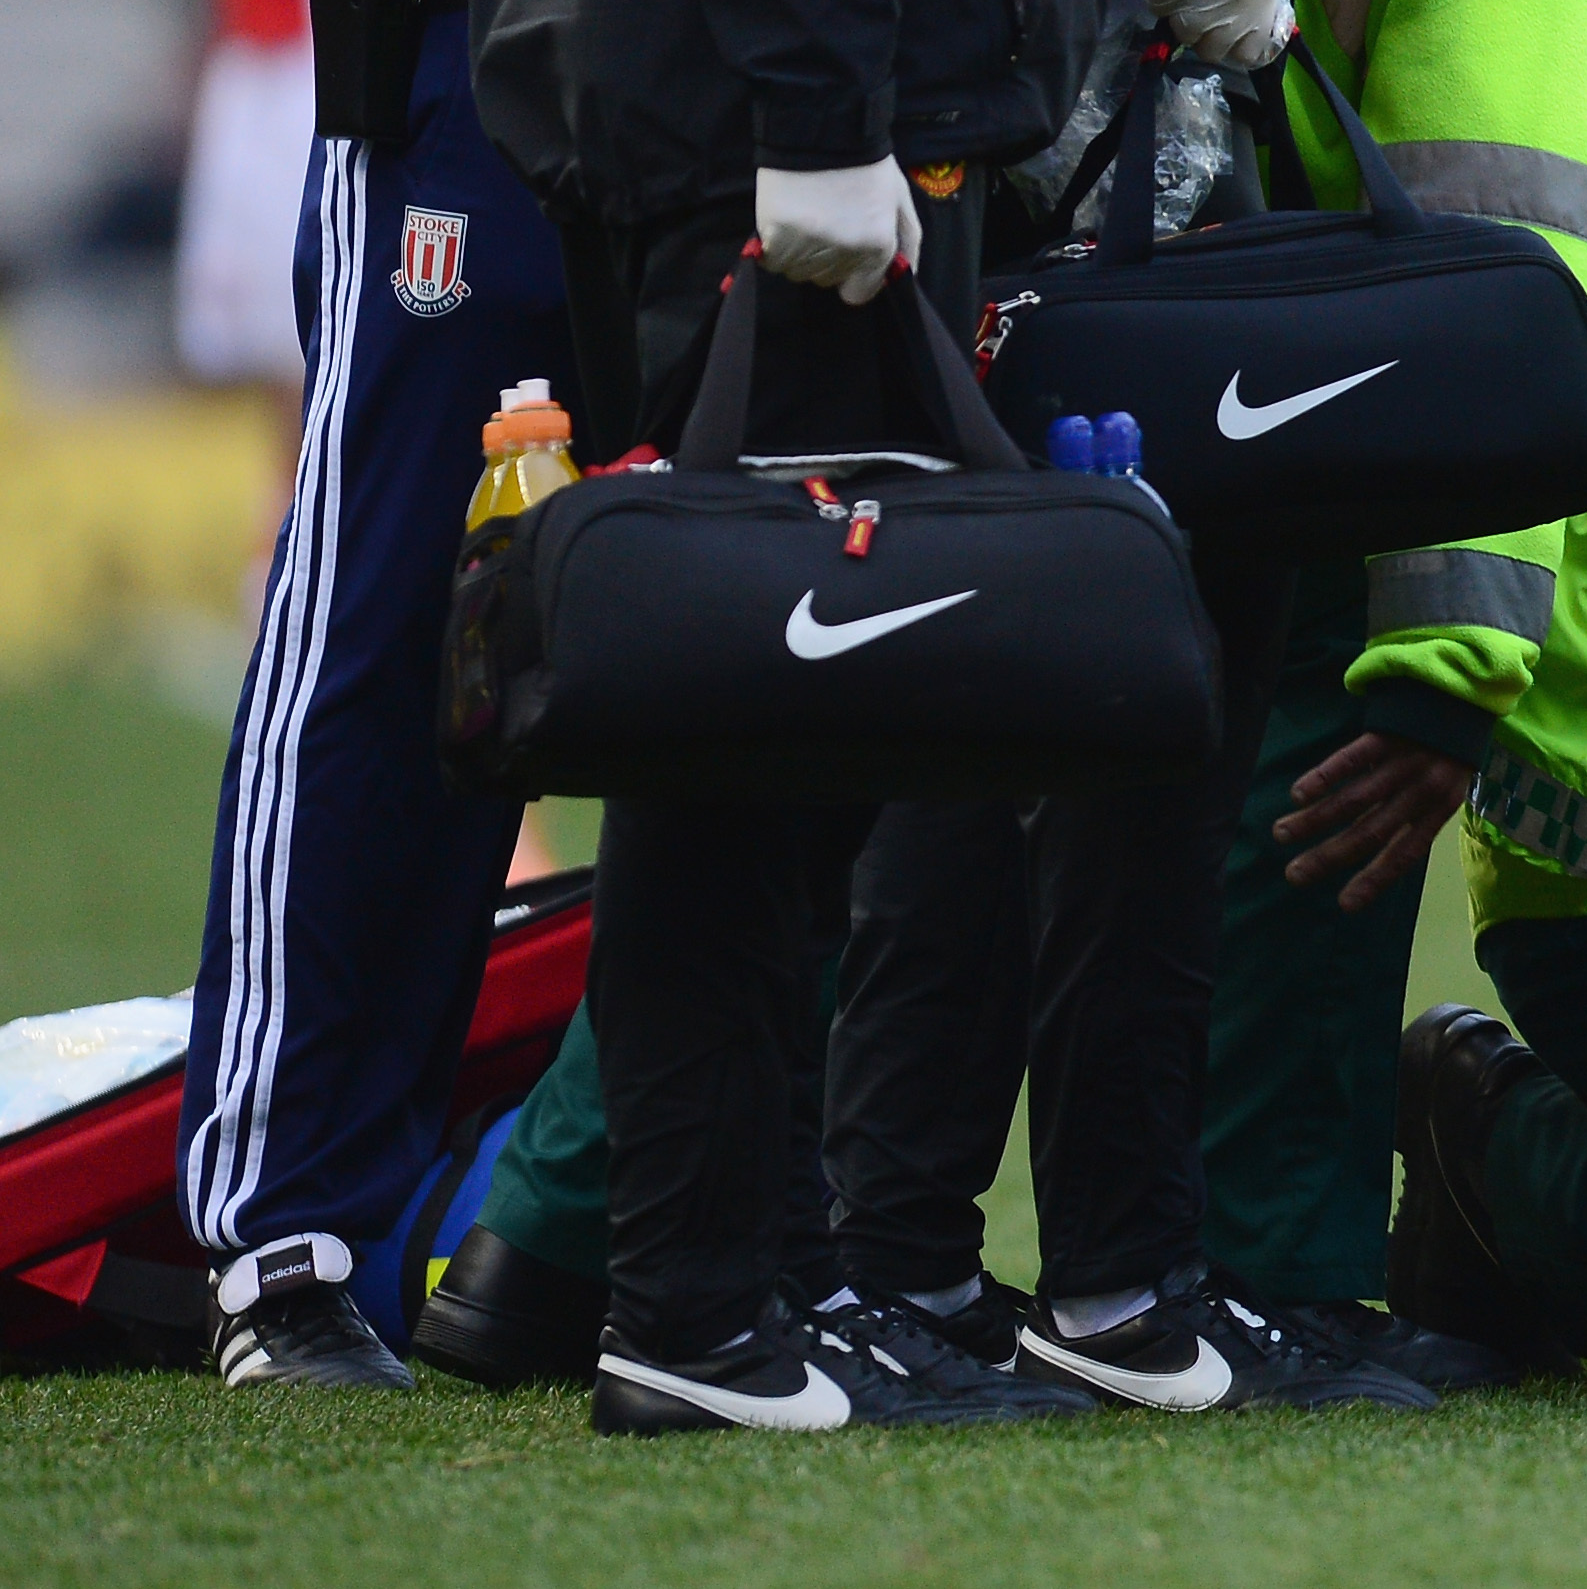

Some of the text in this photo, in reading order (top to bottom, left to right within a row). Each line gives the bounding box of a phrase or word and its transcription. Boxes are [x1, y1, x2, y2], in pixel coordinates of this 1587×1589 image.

[409, 214, 459, 234] STOKE
[417, 231, 444, 243] CITY
[400, 285, 455, 314] THE POTTERS
[262, 1260, 311, 1283] adidas
